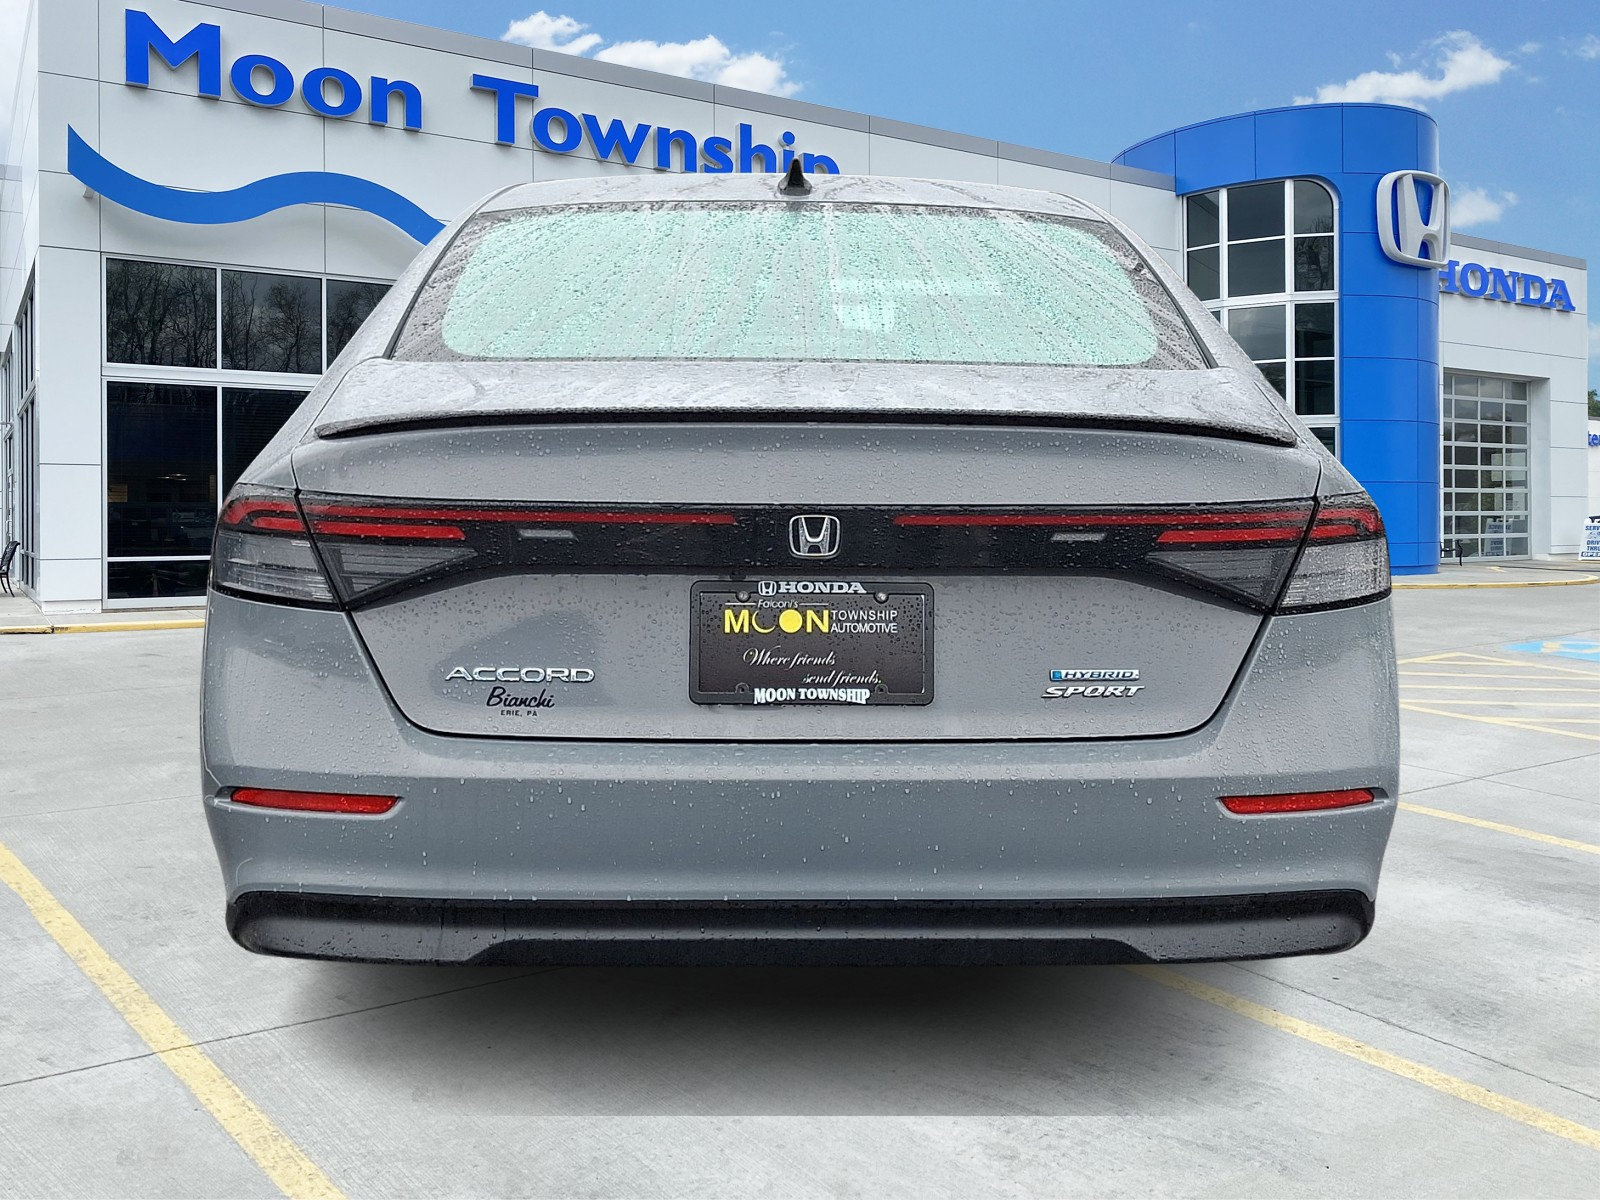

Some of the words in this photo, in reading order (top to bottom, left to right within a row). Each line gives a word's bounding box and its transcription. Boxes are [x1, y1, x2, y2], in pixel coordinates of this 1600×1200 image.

[125, 9, 422, 132] Moon
[1438, 259, 1576, 311] HONDA
[779, 582, 867, 594] HONDA
[757, 599, 799, 609] Falconi's
[724, 609, 829, 634] MOON
[831, 610, 898, 621] TOWNSHIP
[830, 623, 898, 634] AUTOMOTIVE
[743, 645, 791, 665] Where
[788, 650, 837, 669] friends
[445, 666, 595, 683] ACCORD
[802, 671, 833, 685] send
[831, 669, 882, 687] friends.
[1064, 670, 1134, 679] HYBRID
[486, 686, 555, 708] Bianchi
[754, 688, 797, 704] MOON
[799, 687, 871, 705] TOWNSHIP
[1041, 685, 1145, 699] SPORT
[500, 709, 523, 718] ERIE,
[526, 709, 538, 718] PA
